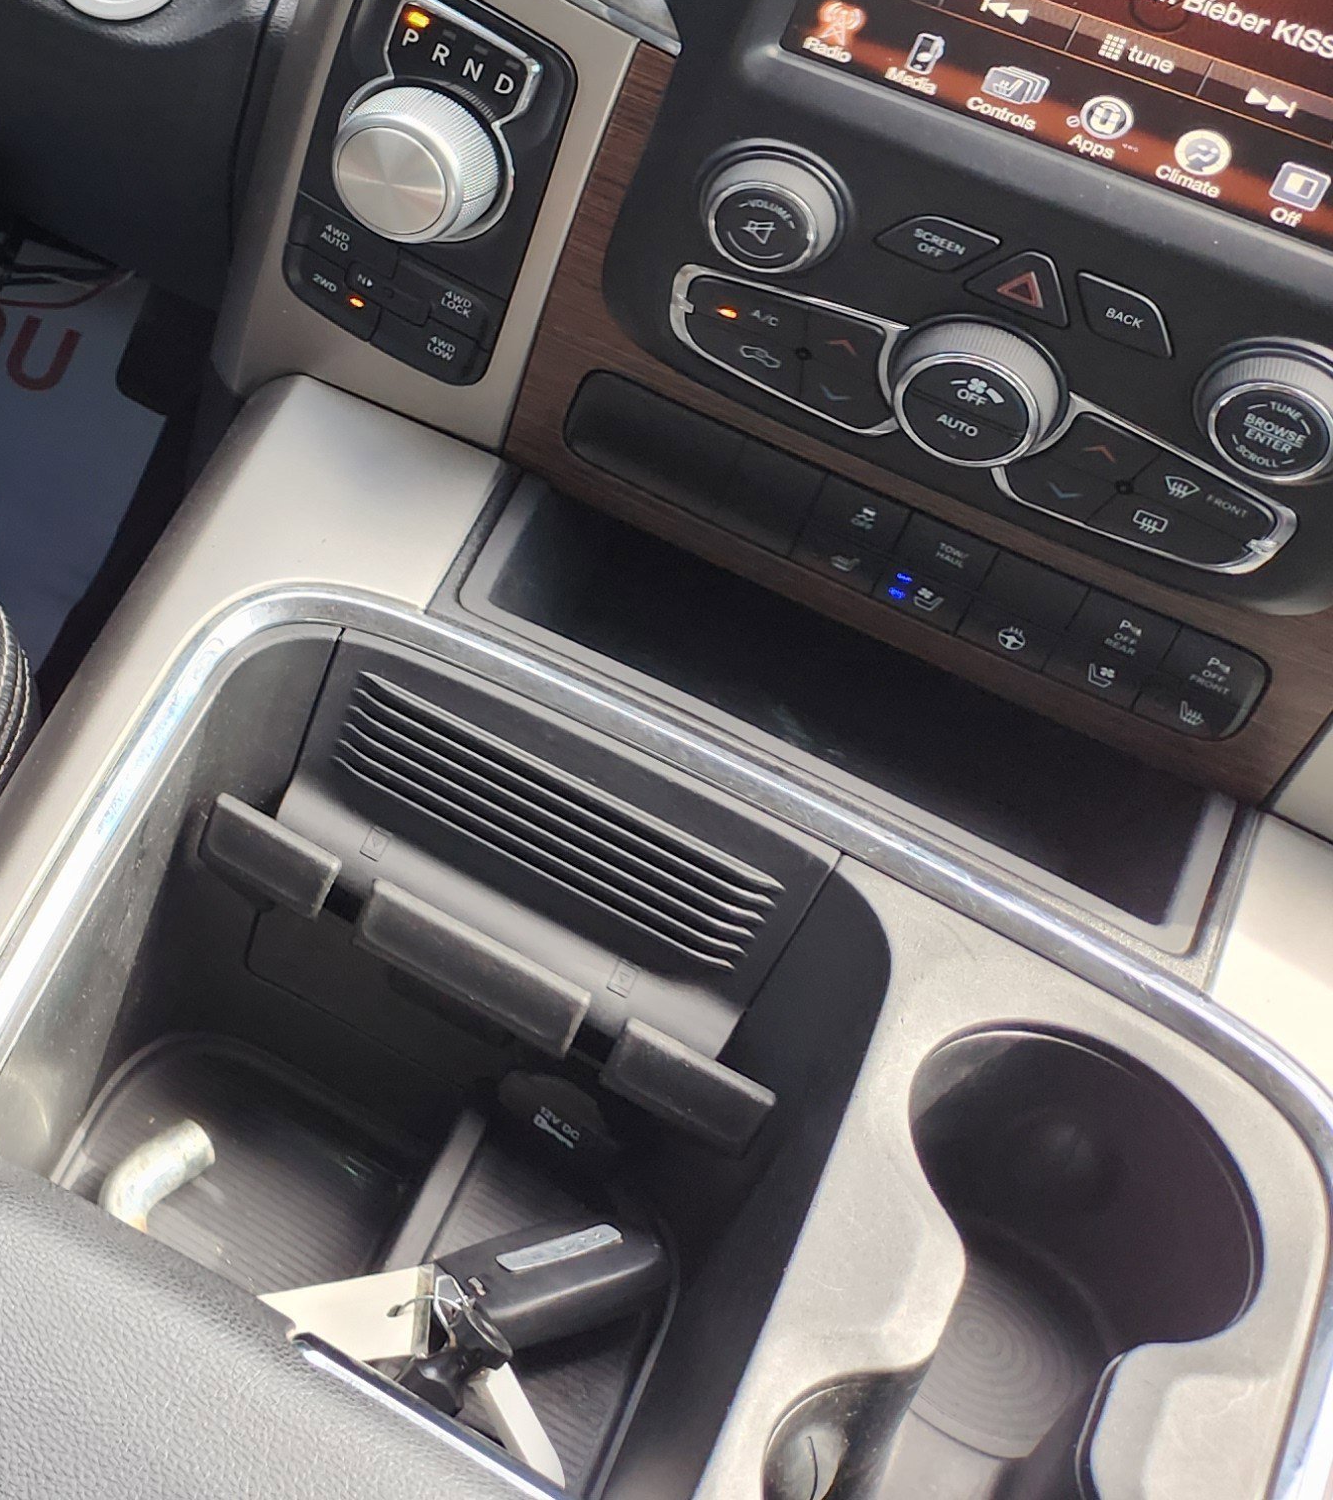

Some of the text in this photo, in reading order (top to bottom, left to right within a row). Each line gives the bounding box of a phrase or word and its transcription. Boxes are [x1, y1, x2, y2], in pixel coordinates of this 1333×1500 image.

[802, 35, 853, 64] Radio
[1127, 42, 1176, 75] tune
[401, 28, 515, 96] P R N D
[884, 65, 938, 96] Media
[966, 96, 1037, 132] Controls
[1067, 133, 1116, 161] Apps
[1155, 164, 1221, 200] Climate
[748, 198, 793, 222] VOLUME
[1269, 206, 1303, 228] Off
[320, 231, 350, 252] AUTO
[325, 223, 351, 243] 4WD
[914, 227, 967, 256] SCREEN
[917, 242, 944, 258] OFF
[311, 272, 338, 293] 2WD
[440, 296, 472, 319] LOCK
[445, 290, 473, 309] 4WD
[751, 308, 780, 328] A/C
[1105, 306, 1145, 329] BACK
[426, 342, 455, 362] LOW
[430, 335, 456, 353] 4WD
[956, 387, 988, 407] OFF
[1269, 400, 1303, 421] TUNE
[936, 412, 979, 438] AUTO
[1244, 412, 1308, 447] BROWSE
[1244, 428, 1293, 455] ENTER
[1235, 444, 1279, 468] SCROLL
[1206, 493, 1250, 518] FRONT
[935, 551, 965, 569] HAUL
[1189, 673, 1231, 695] FRONT
[1202, 669, 1228, 683] OFF
